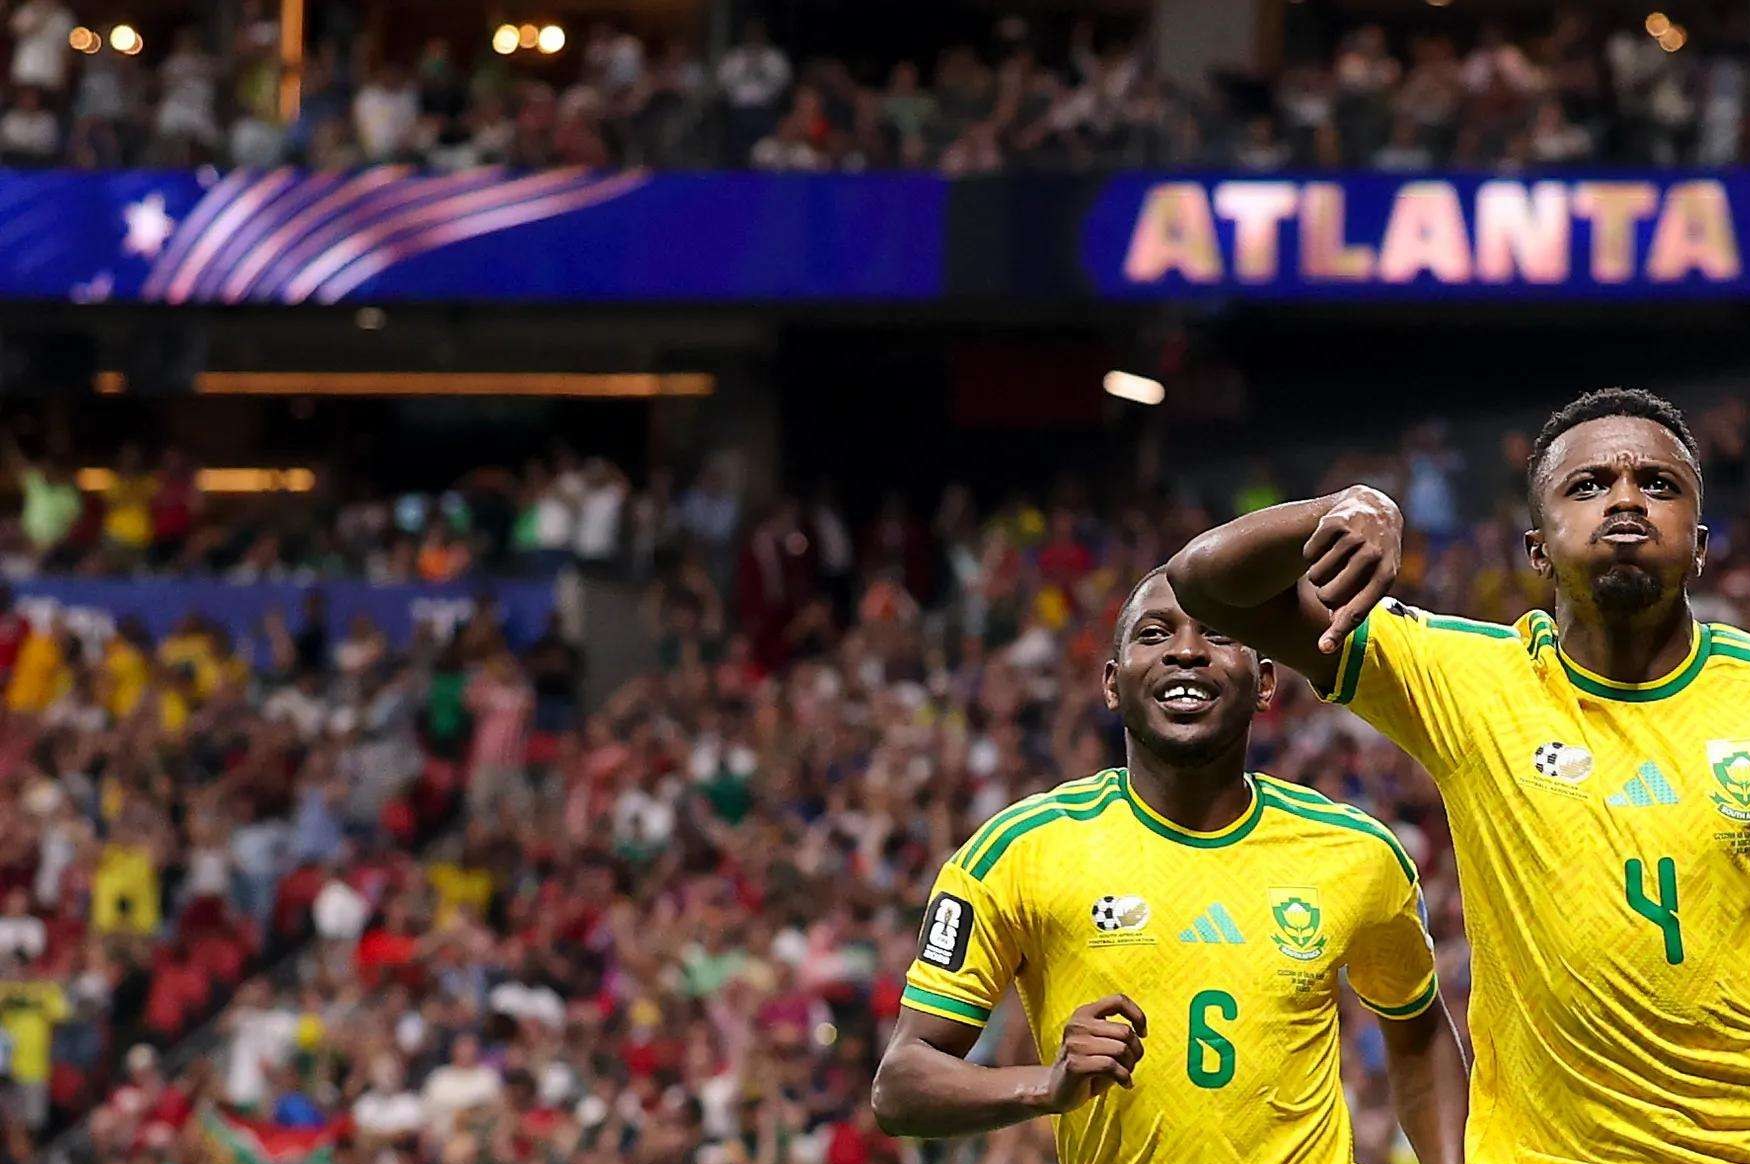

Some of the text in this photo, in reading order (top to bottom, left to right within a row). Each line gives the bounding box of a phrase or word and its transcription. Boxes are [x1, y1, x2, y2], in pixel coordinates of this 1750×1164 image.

[1125, 182, 1740, 283] ATLANTA
[1624, 856, 1685, 966] 4
[1187, 989, 1238, 1089] 6
